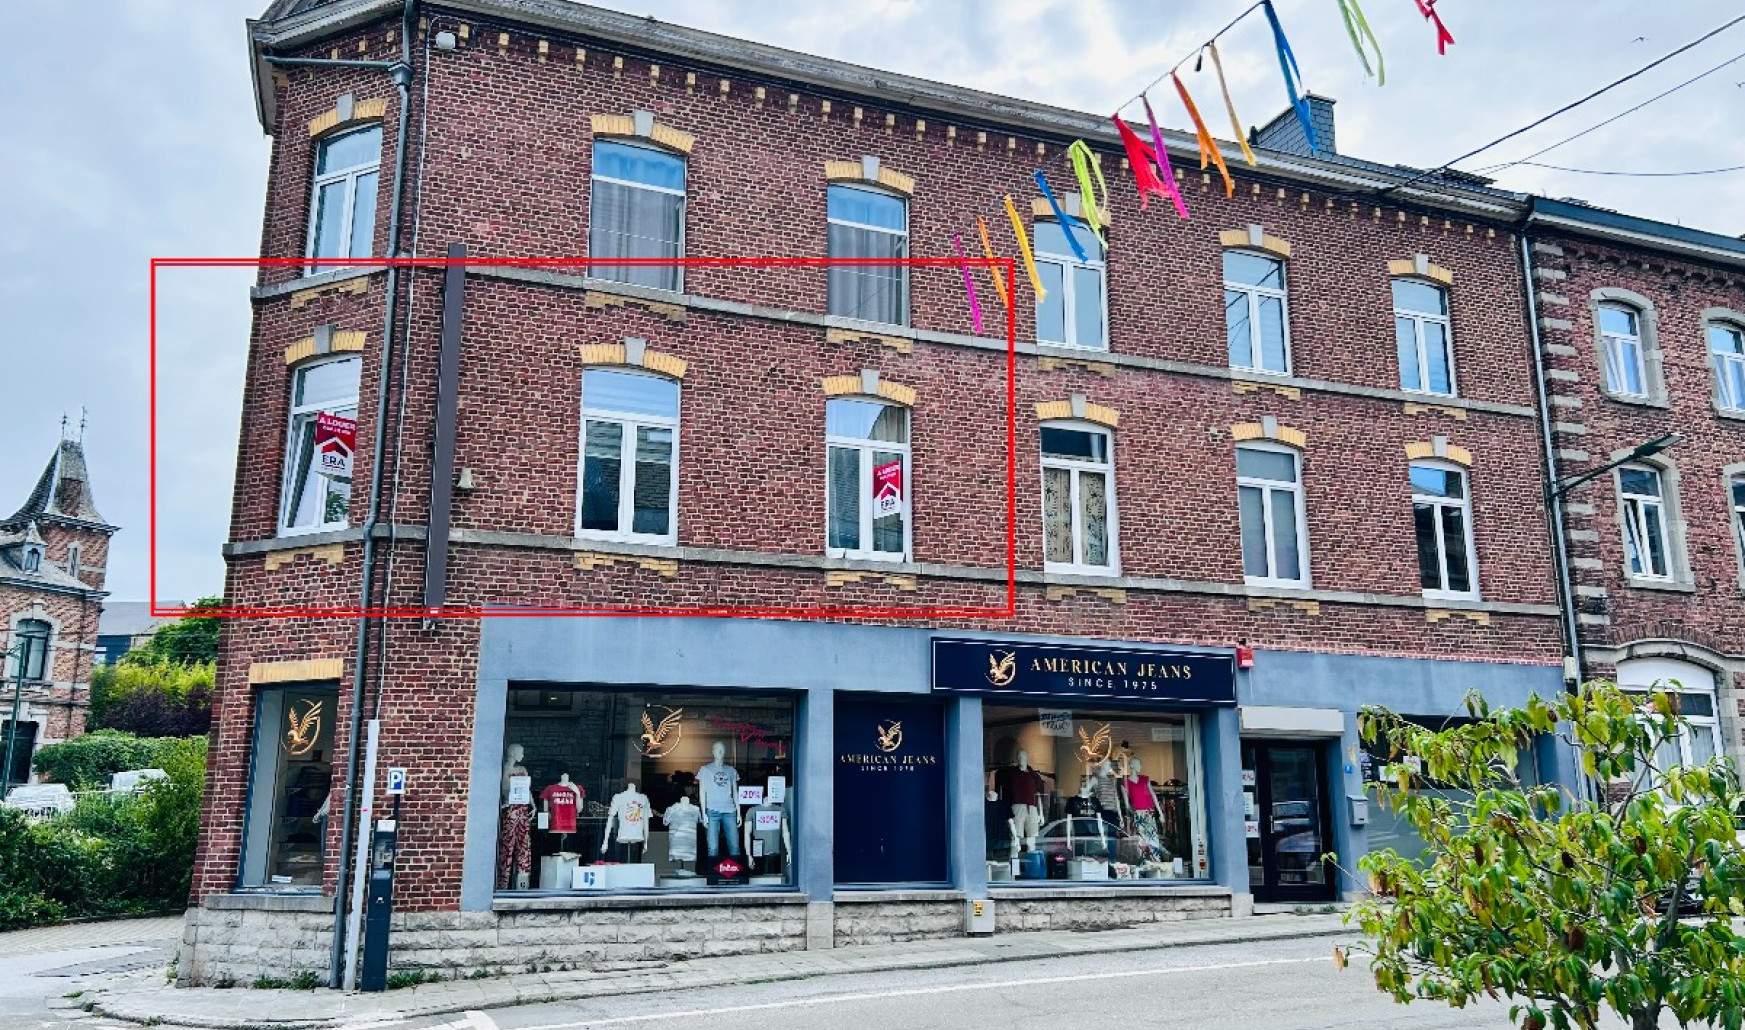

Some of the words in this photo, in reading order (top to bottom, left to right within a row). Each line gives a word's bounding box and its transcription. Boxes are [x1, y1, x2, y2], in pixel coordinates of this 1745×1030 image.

[327, 418, 356, 431] LOUER
[322, 455, 345, 467] ERA
[1030, 657, 1127, 676] AMERICAN
[1137, 663, 1192, 680] JEANS
[1068, 676, 1113, 689] SINCE
[1124, 679, 1157, 690] 1975
[841, 754, 897, 764] AMERICAN
[902, 755, 936, 764] JEANS
[390, 771, 402, 789] P
